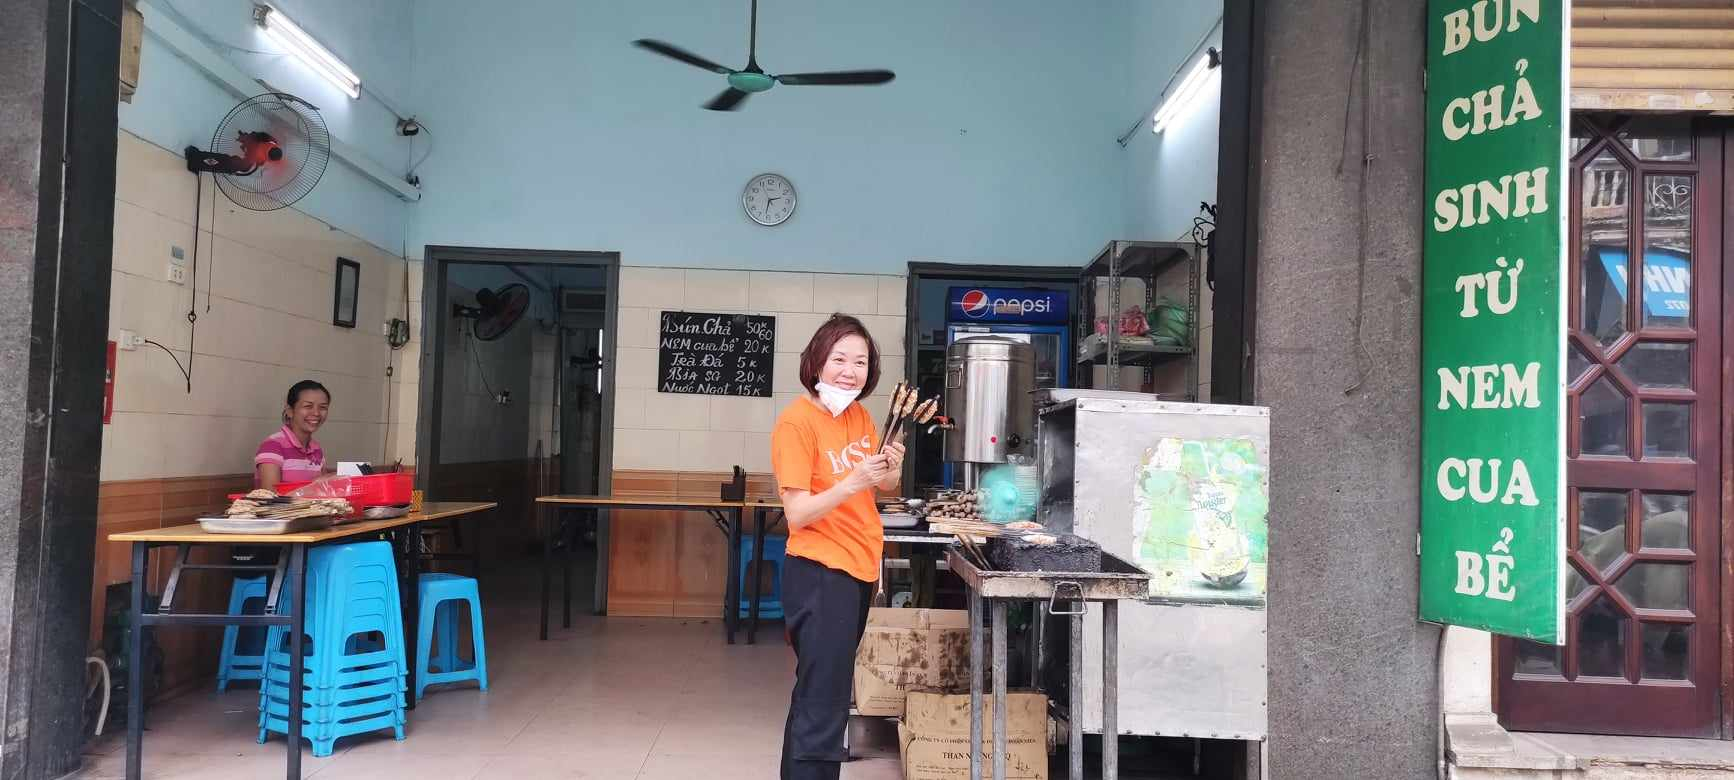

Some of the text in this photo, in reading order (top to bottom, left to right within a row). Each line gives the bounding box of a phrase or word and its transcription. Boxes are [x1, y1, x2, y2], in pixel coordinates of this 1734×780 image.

[1442, 58, 1543, 142] CHẢ
[1433, 167, 1549, 233] SINH
[993, 296, 1051, 316] pepsi
[1455, 256, 1524, 318] TỪ
[703, 316, 732, 335] Chả
[700, 352, 724, 367] Đá
[704, 370, 721, 382] SG
[1437, 361, 1541, 410] NEM
[1437, 456, 1540, 506] CUA
[1455, 527, 1516, 601] BỂ
